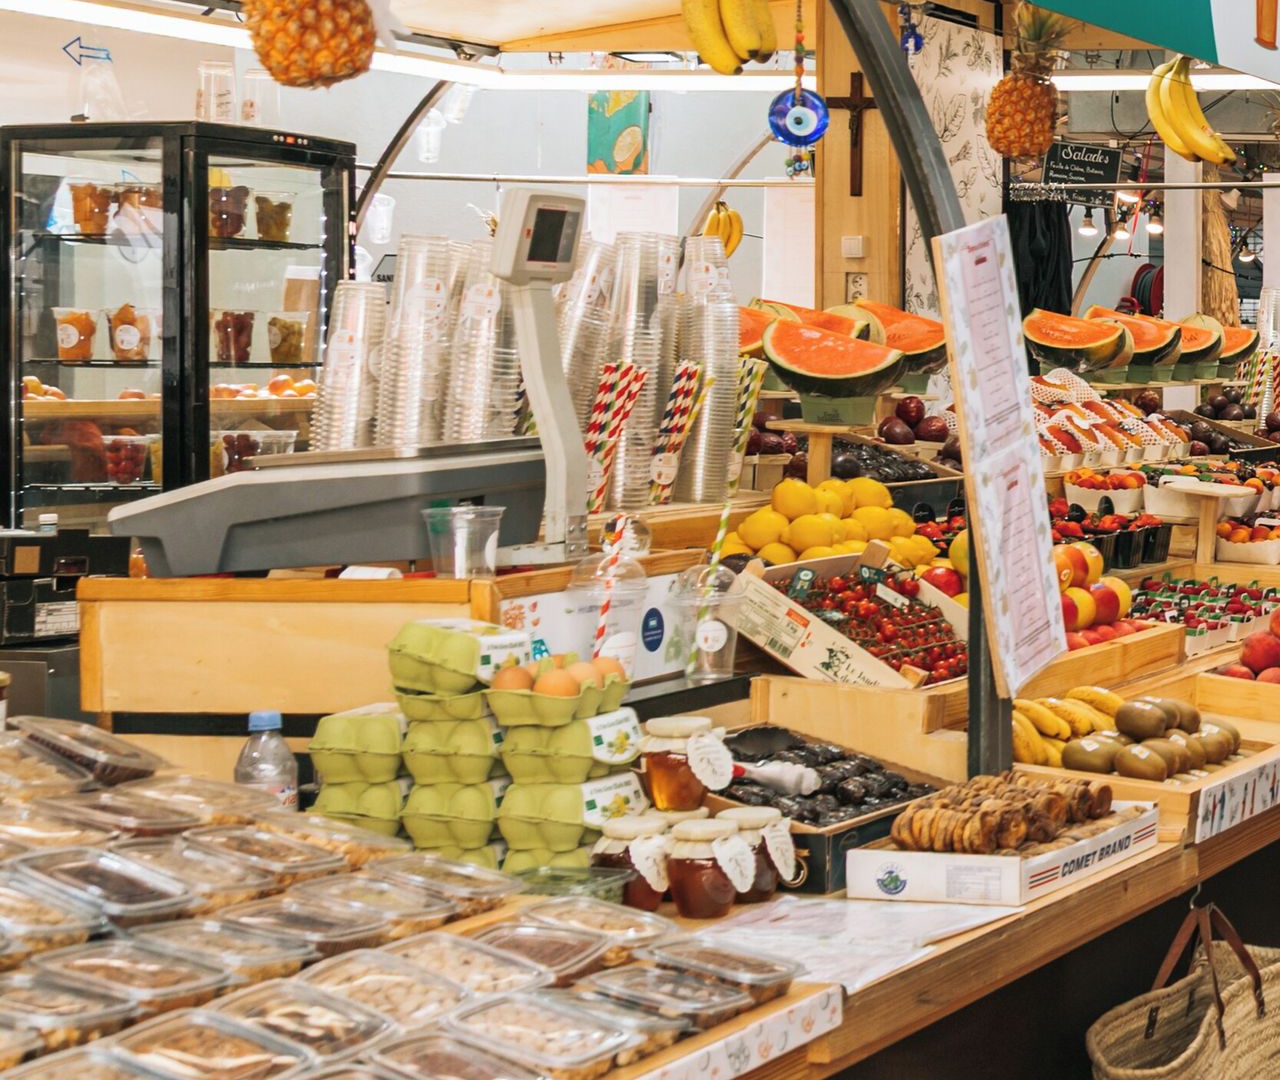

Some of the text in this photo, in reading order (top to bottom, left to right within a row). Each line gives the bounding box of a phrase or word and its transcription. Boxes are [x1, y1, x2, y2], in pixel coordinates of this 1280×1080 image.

[1061, 144, 1109, 164] Salades
[1061, 834, 1132, 878] COMET BRAND
